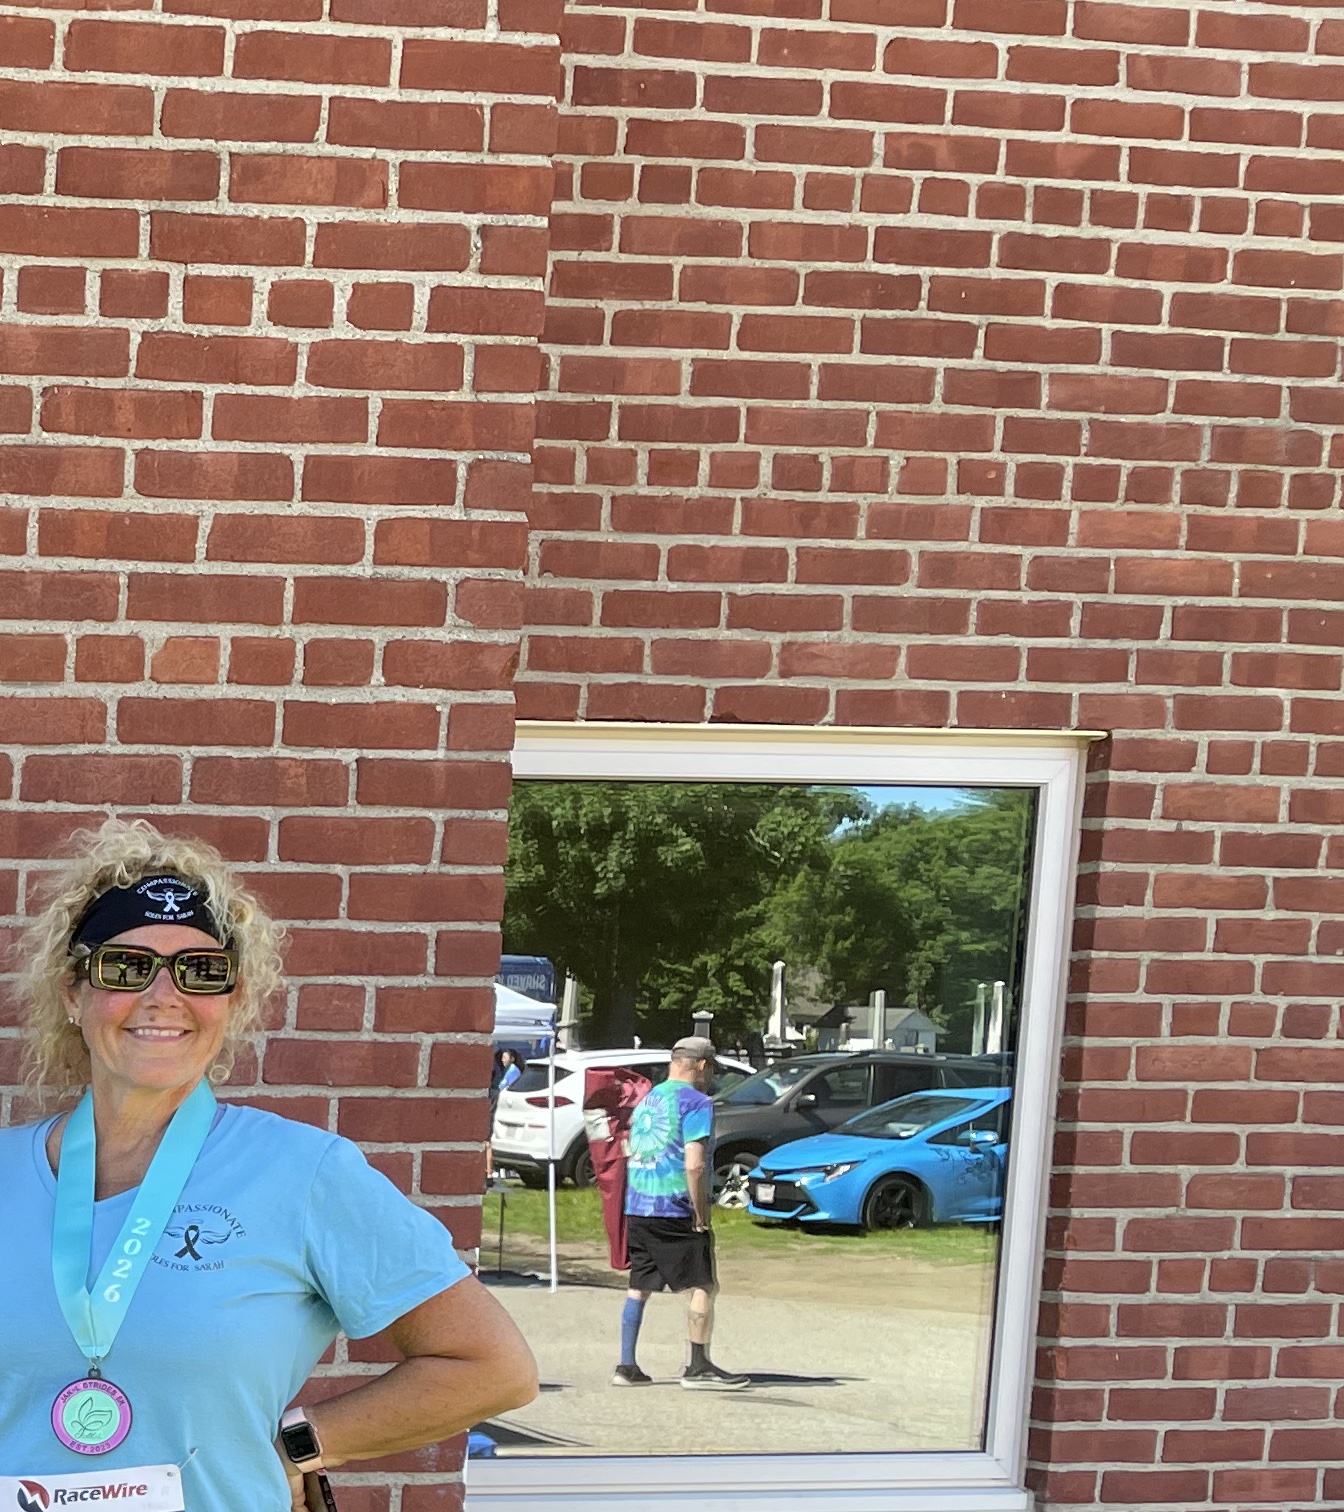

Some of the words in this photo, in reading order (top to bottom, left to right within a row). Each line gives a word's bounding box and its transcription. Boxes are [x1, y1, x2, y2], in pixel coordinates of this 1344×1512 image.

[173, 1203, 247, 1239] PASSIONATE
[103, 1217, 152, 1303] 2026
[53, 1482, 149, 1506] RaceWire
